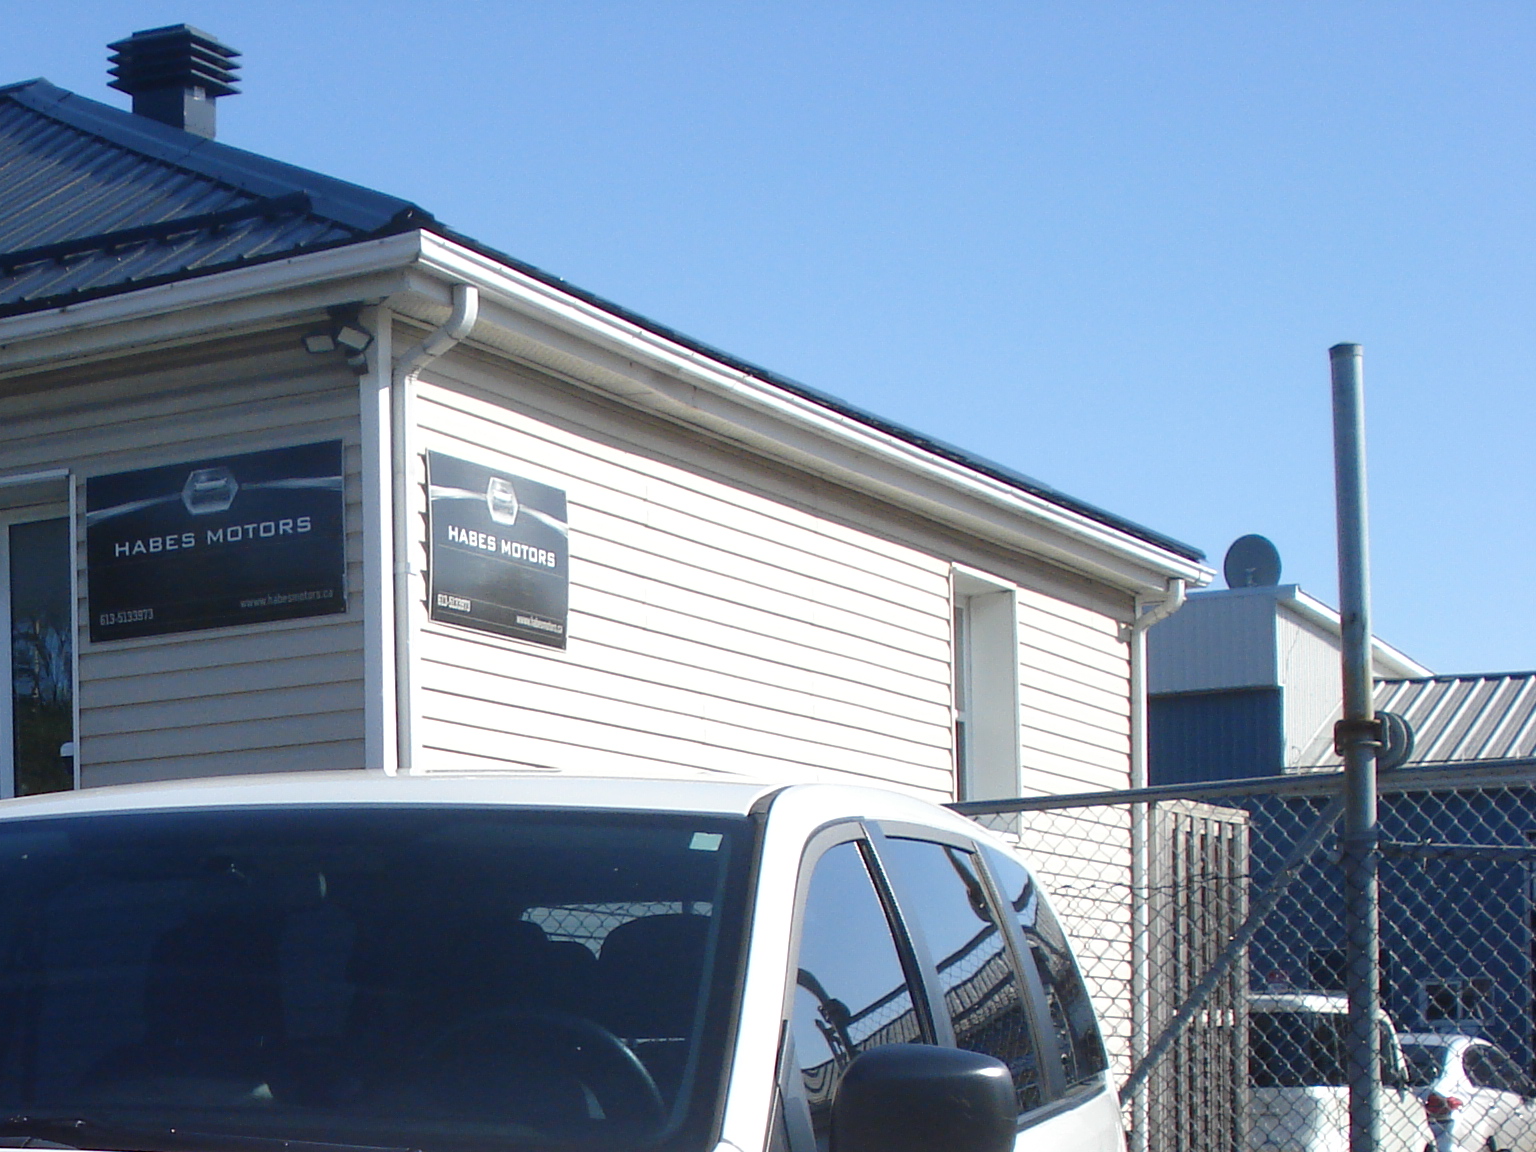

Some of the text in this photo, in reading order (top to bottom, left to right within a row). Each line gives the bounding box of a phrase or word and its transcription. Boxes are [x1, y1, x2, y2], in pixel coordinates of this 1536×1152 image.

[114, 515, 312, 558] HABES MOTORS
[447, 524, 556, 568] HABES MOTORS
[99, 608, 154, 626] 613-5133973
